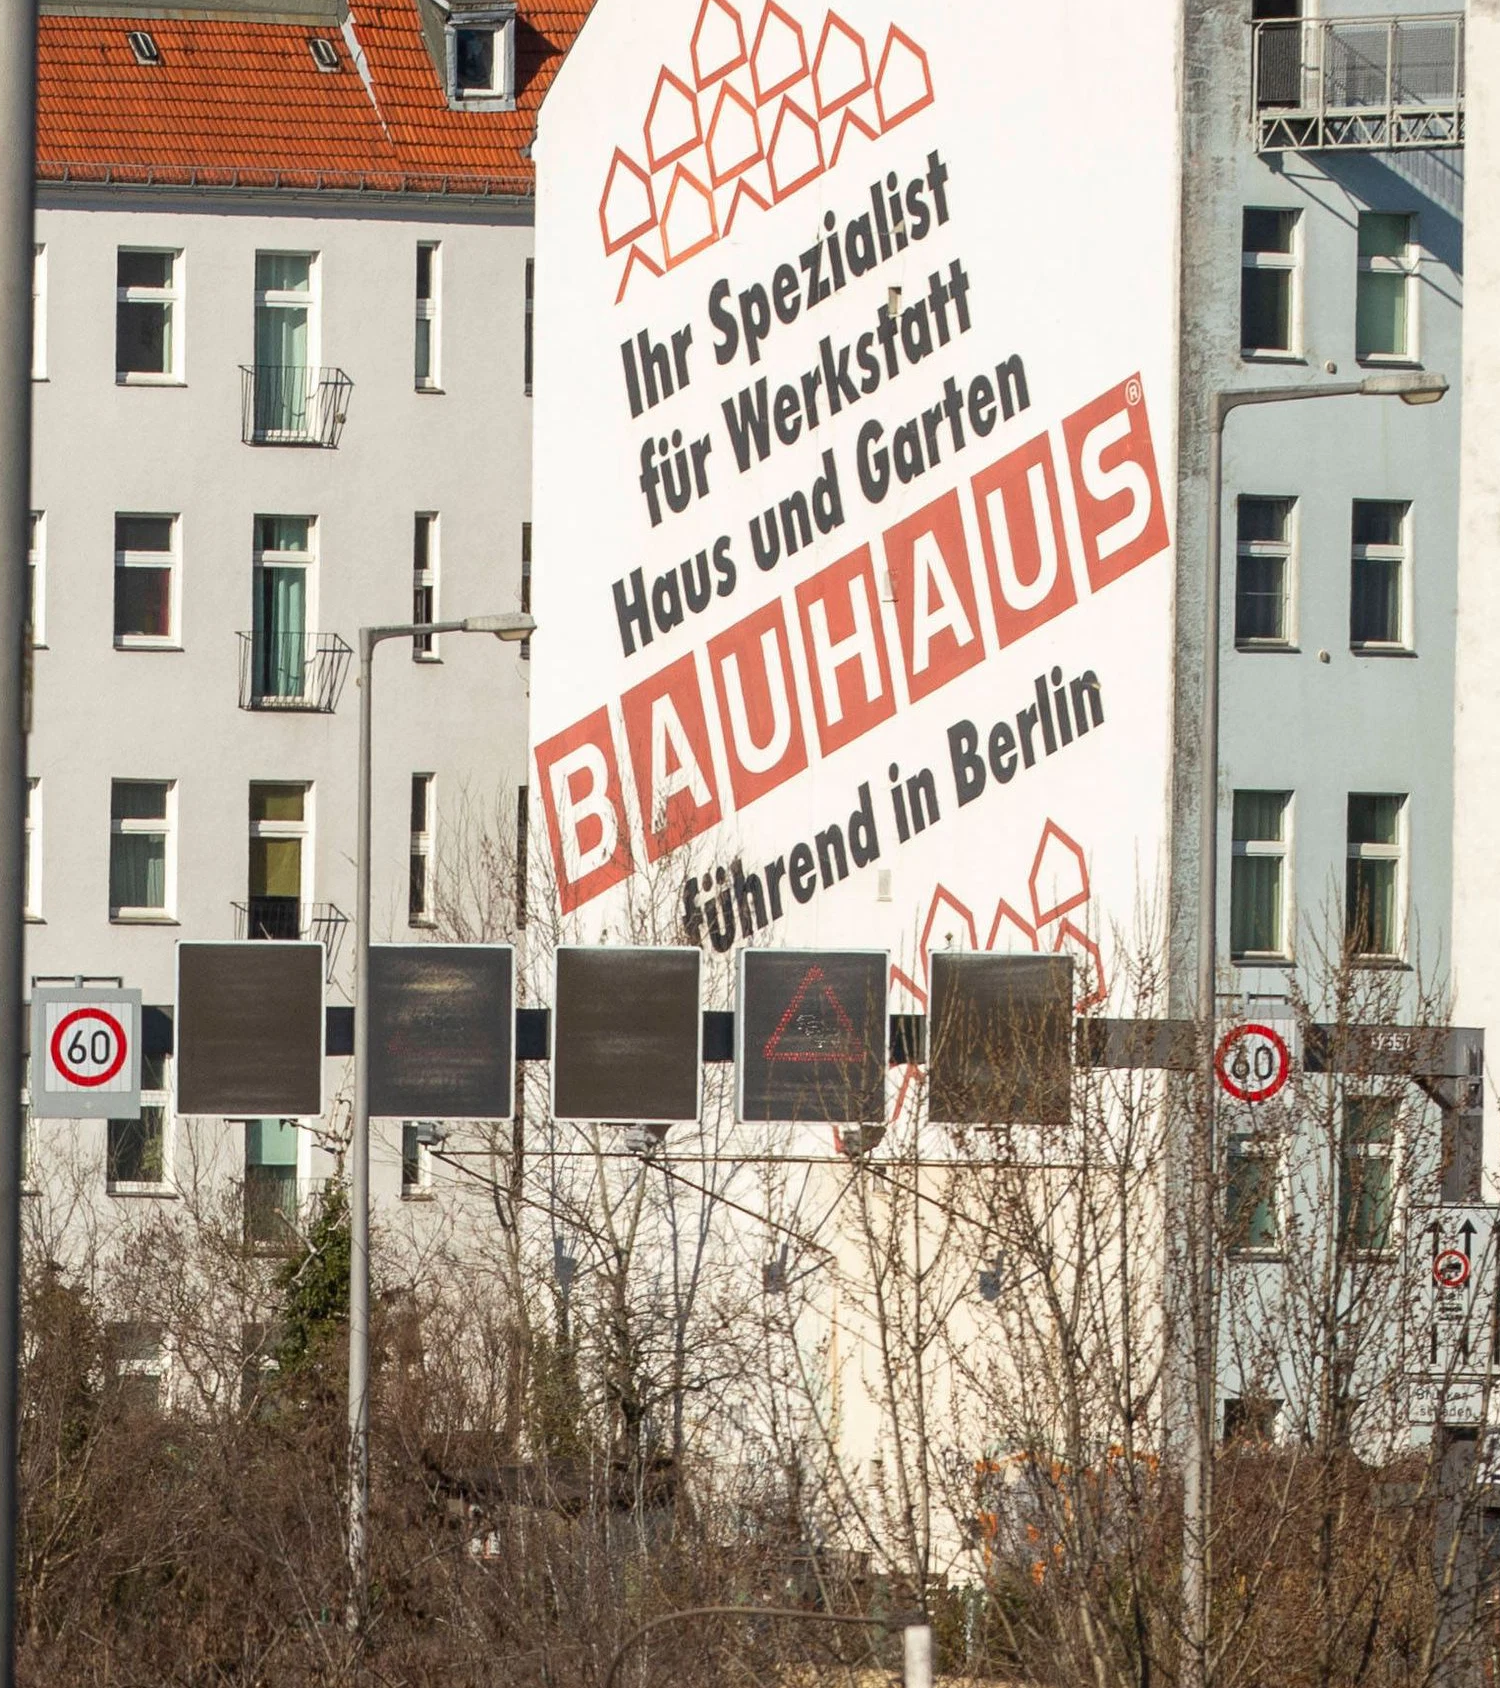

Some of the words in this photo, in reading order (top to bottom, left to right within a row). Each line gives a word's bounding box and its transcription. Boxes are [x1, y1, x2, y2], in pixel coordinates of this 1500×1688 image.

[620, 323, 693, 419] Ihr
[708, 149, 949, 366] Spezialist
[638, 436, 713, 528] für
[721, 258, 973, 473] Werkstatt
[612, 536, 737, 658] Haus
[749, 448, 846, 572] und
[855, 353, 1031, 505] Garten
[681, 781, 881, 955] führend
[889, 762, 942, 846] in
[946, 665, 1106, 809] Berlin
[67, 1030, 111, 1065] 60
[1231, 1043, 1274, 1083] 60
